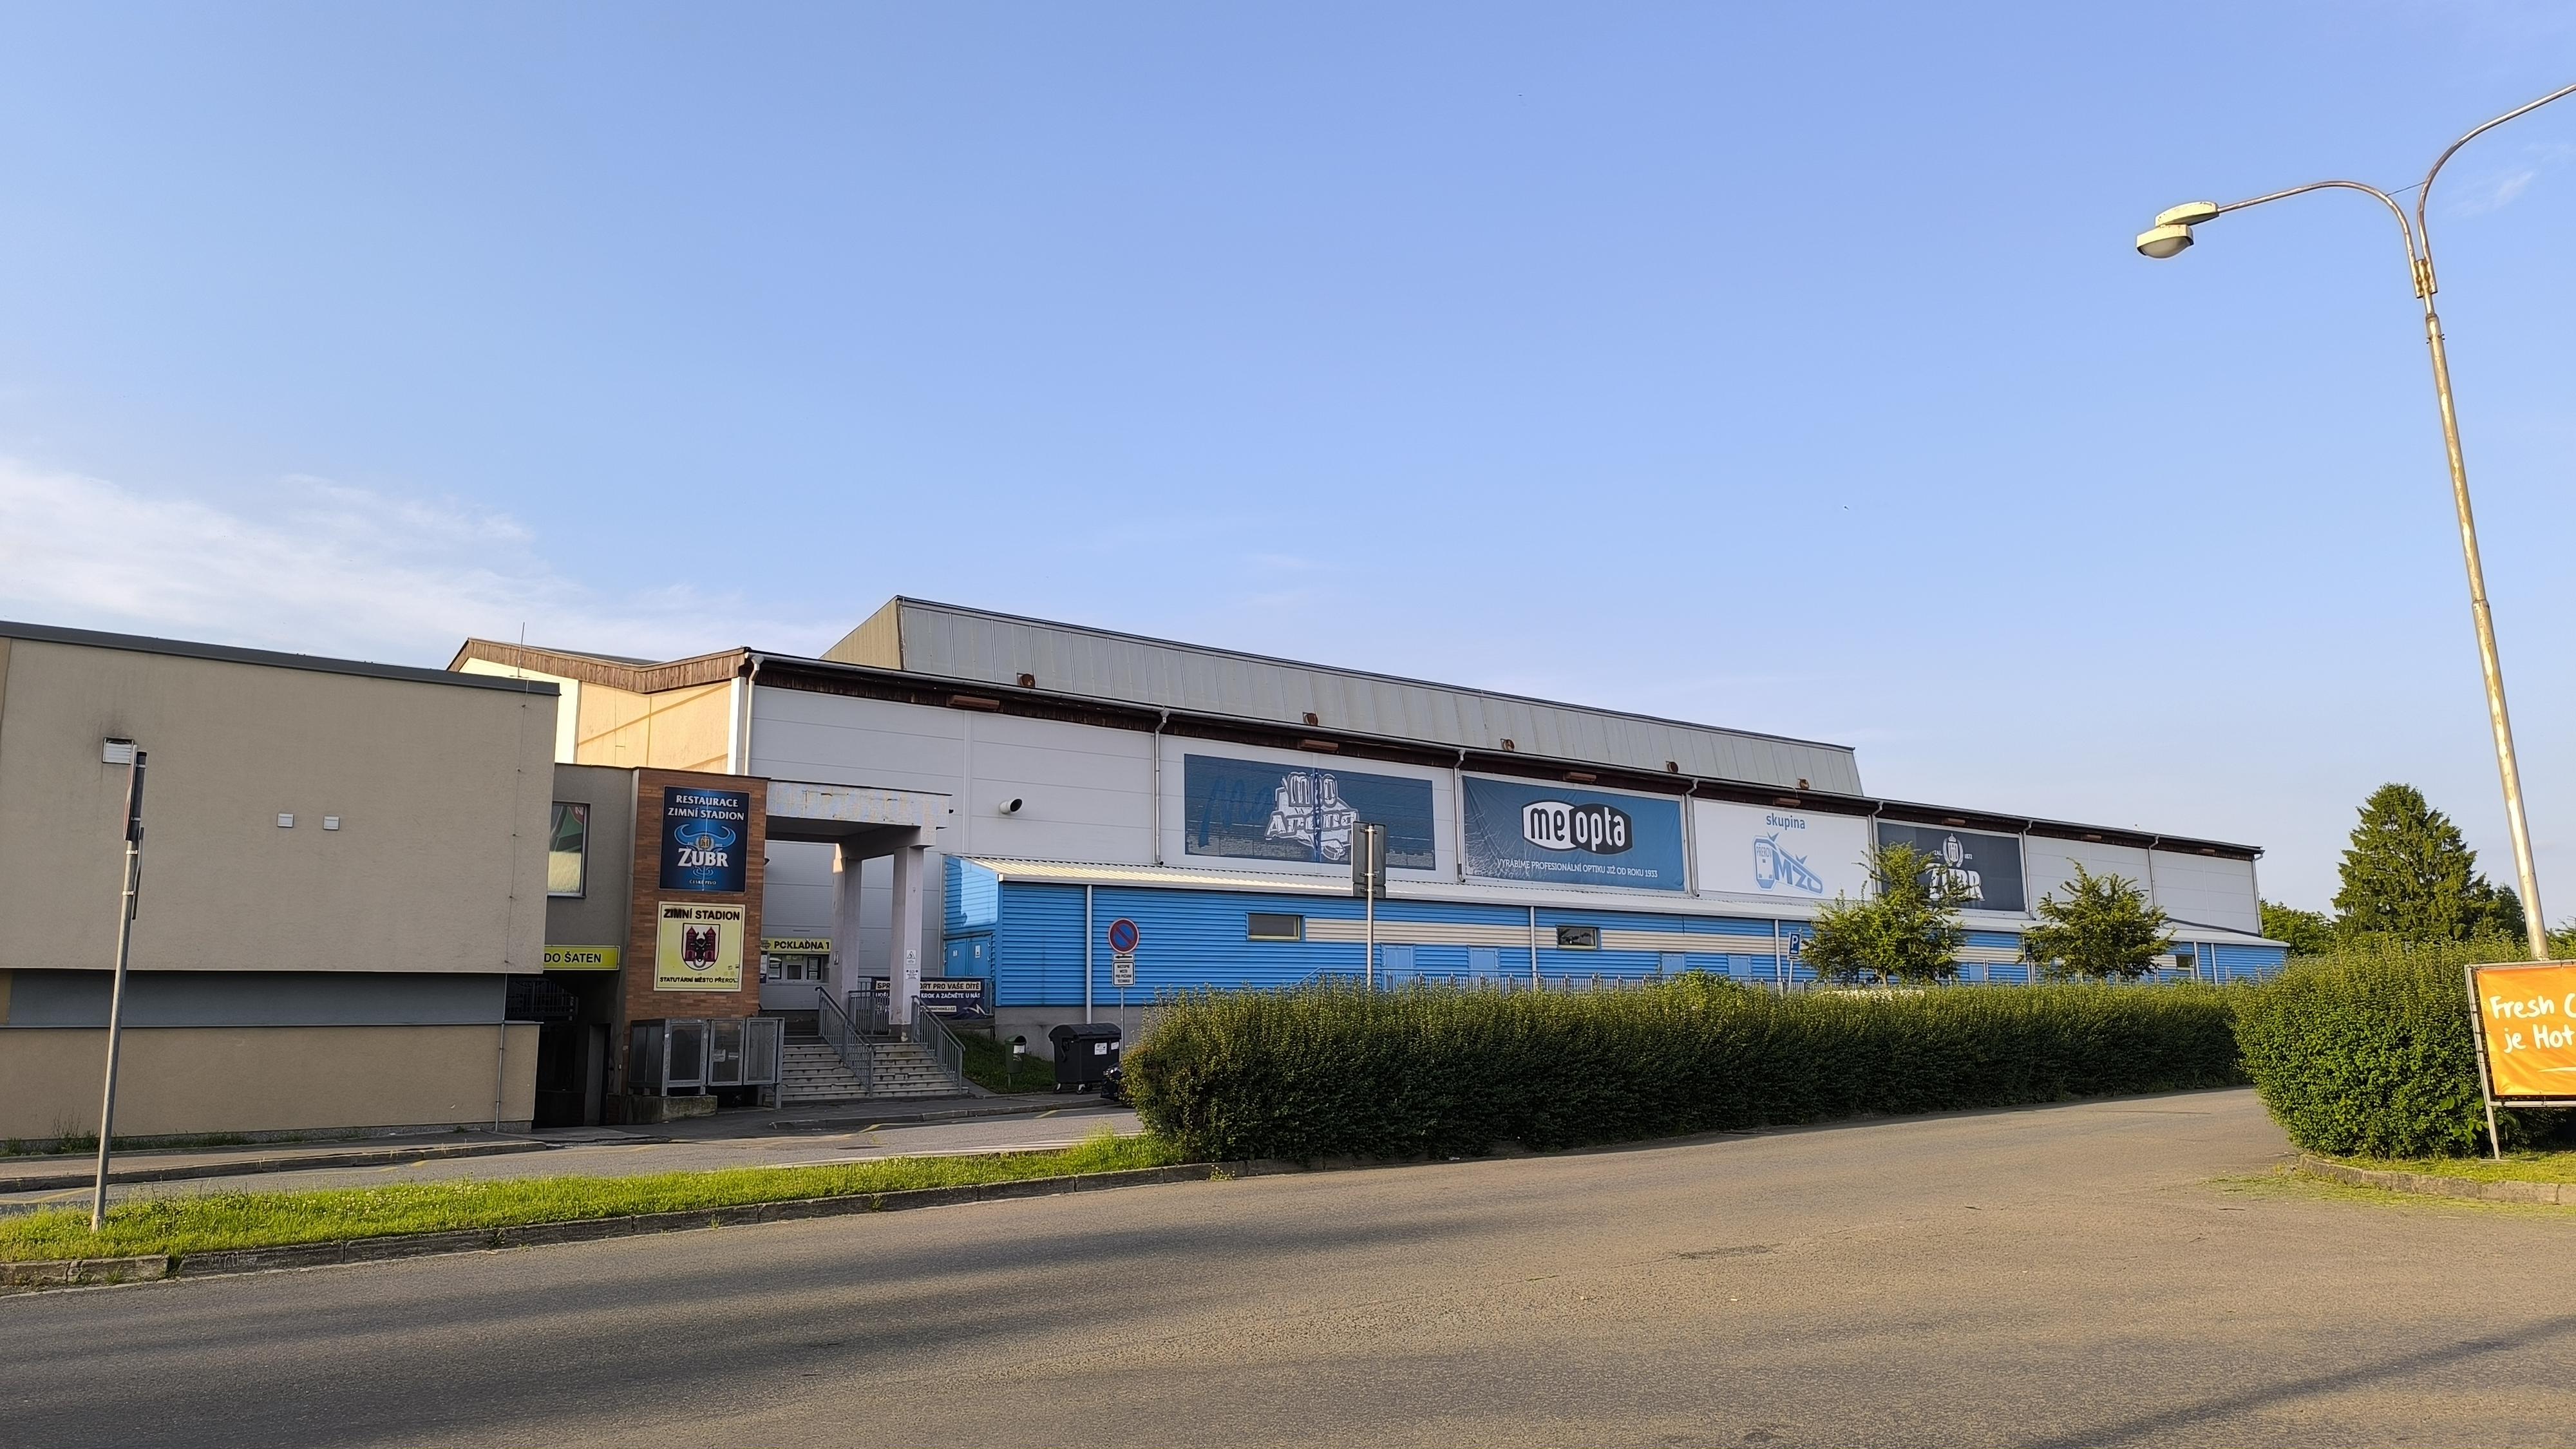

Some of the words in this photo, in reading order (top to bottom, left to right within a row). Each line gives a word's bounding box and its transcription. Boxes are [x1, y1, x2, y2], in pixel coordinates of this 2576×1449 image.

[676, 795, 738, 807] RESTAURACE
[668, 808, 699, 817] ZIMNÍ
[701, 810, 744, 820] STADION
[1766, 813, 1806, 831] skupina
[1530, 807, 1625, 851] meopta
[677, 848, 728, 867] ZUBR
[1497, 858, 1530, 869] VYRÁBÍME
[1531, 860, 1582, 872] PROFESIONÁLNÍ
[1582, 864, 1605, 874] OPTIKU
[1606, 865, 1616, 875] JIŽ
[1627, 868, 1644, 876] ROKU
[1645, 869, 1658, 878] 1933
[663, 907, 692, 919] ZIMNÍ
[695, 910, 740, 921] STADION
[544, 952, 561, 963] DO
[564, 951, 601, 963] ŠATEN
[2489, 996, 2555, 1019] Fresh
[2504, 1027, 2526, 1054] je
[2532, 1024, 2575, 1050] Hot
